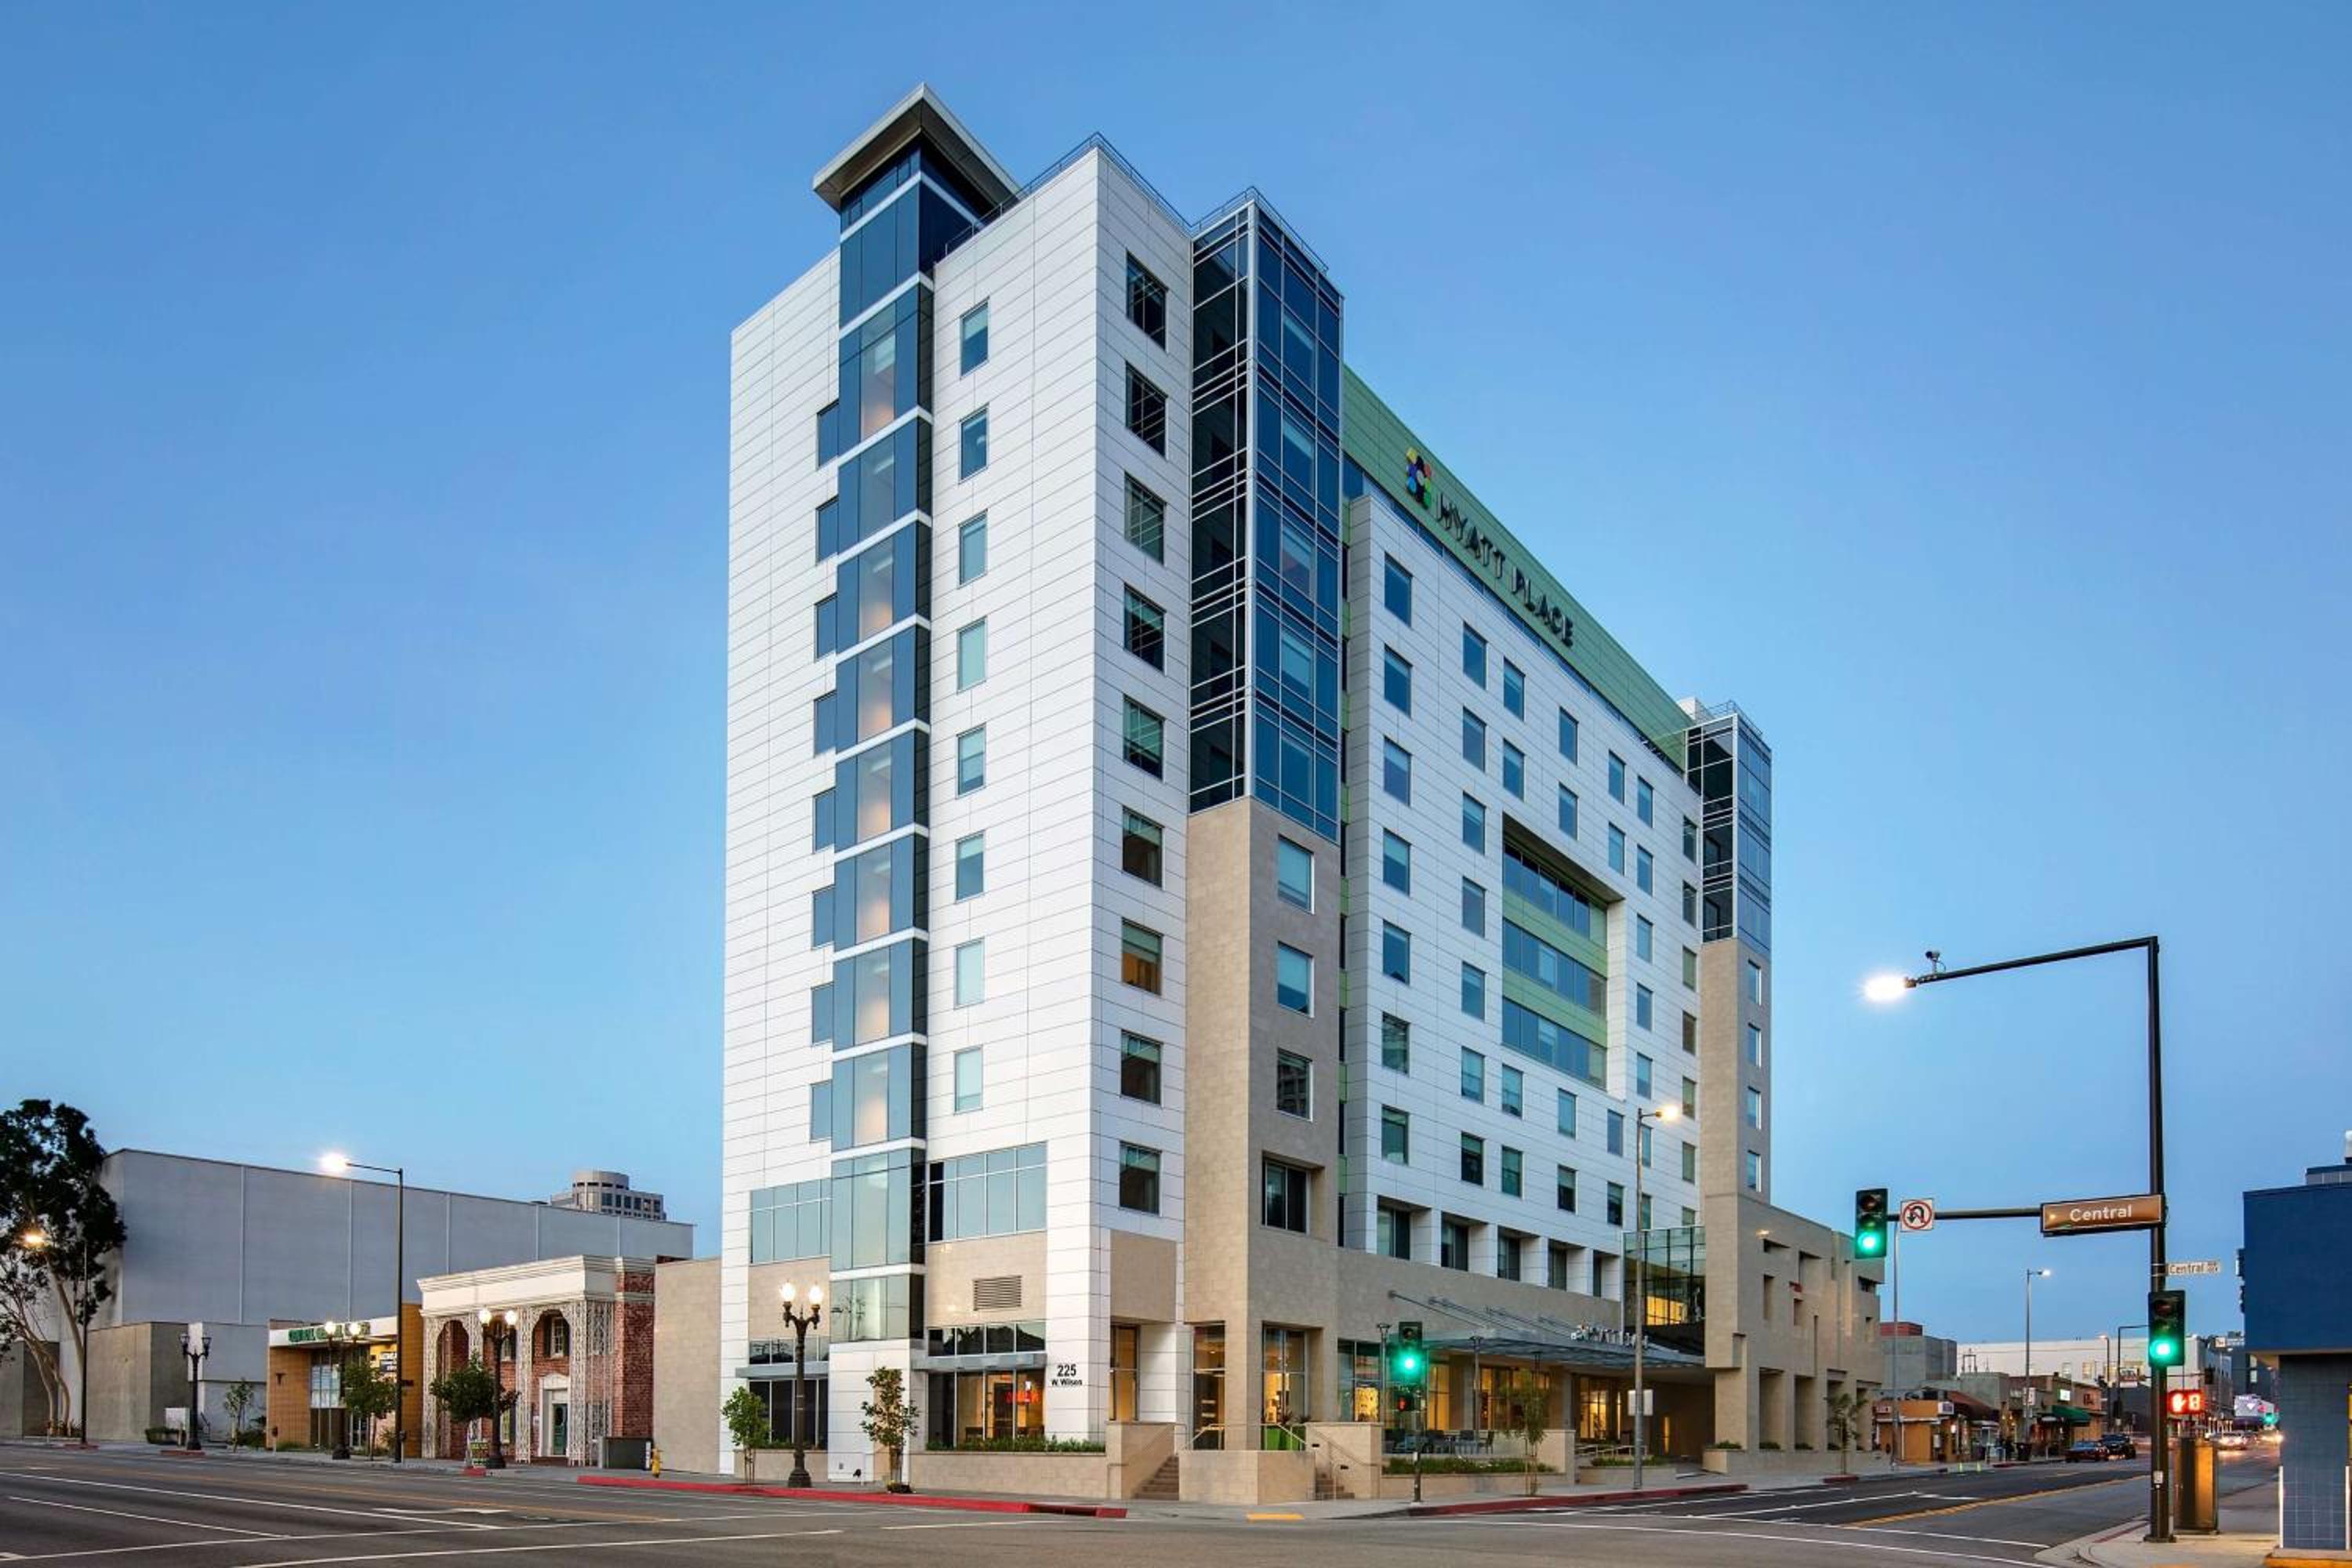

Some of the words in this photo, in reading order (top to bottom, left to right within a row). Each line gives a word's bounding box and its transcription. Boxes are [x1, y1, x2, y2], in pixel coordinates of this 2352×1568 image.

[1437, 492, 1505, 580] HYATT
[1512, 565, 1573, 648] PLACE
[2070, 1204, 2132, 1221] Central
[2169, 1262, 2205, 1274] Central
[1057, 1363, 1076, 1377] 225
